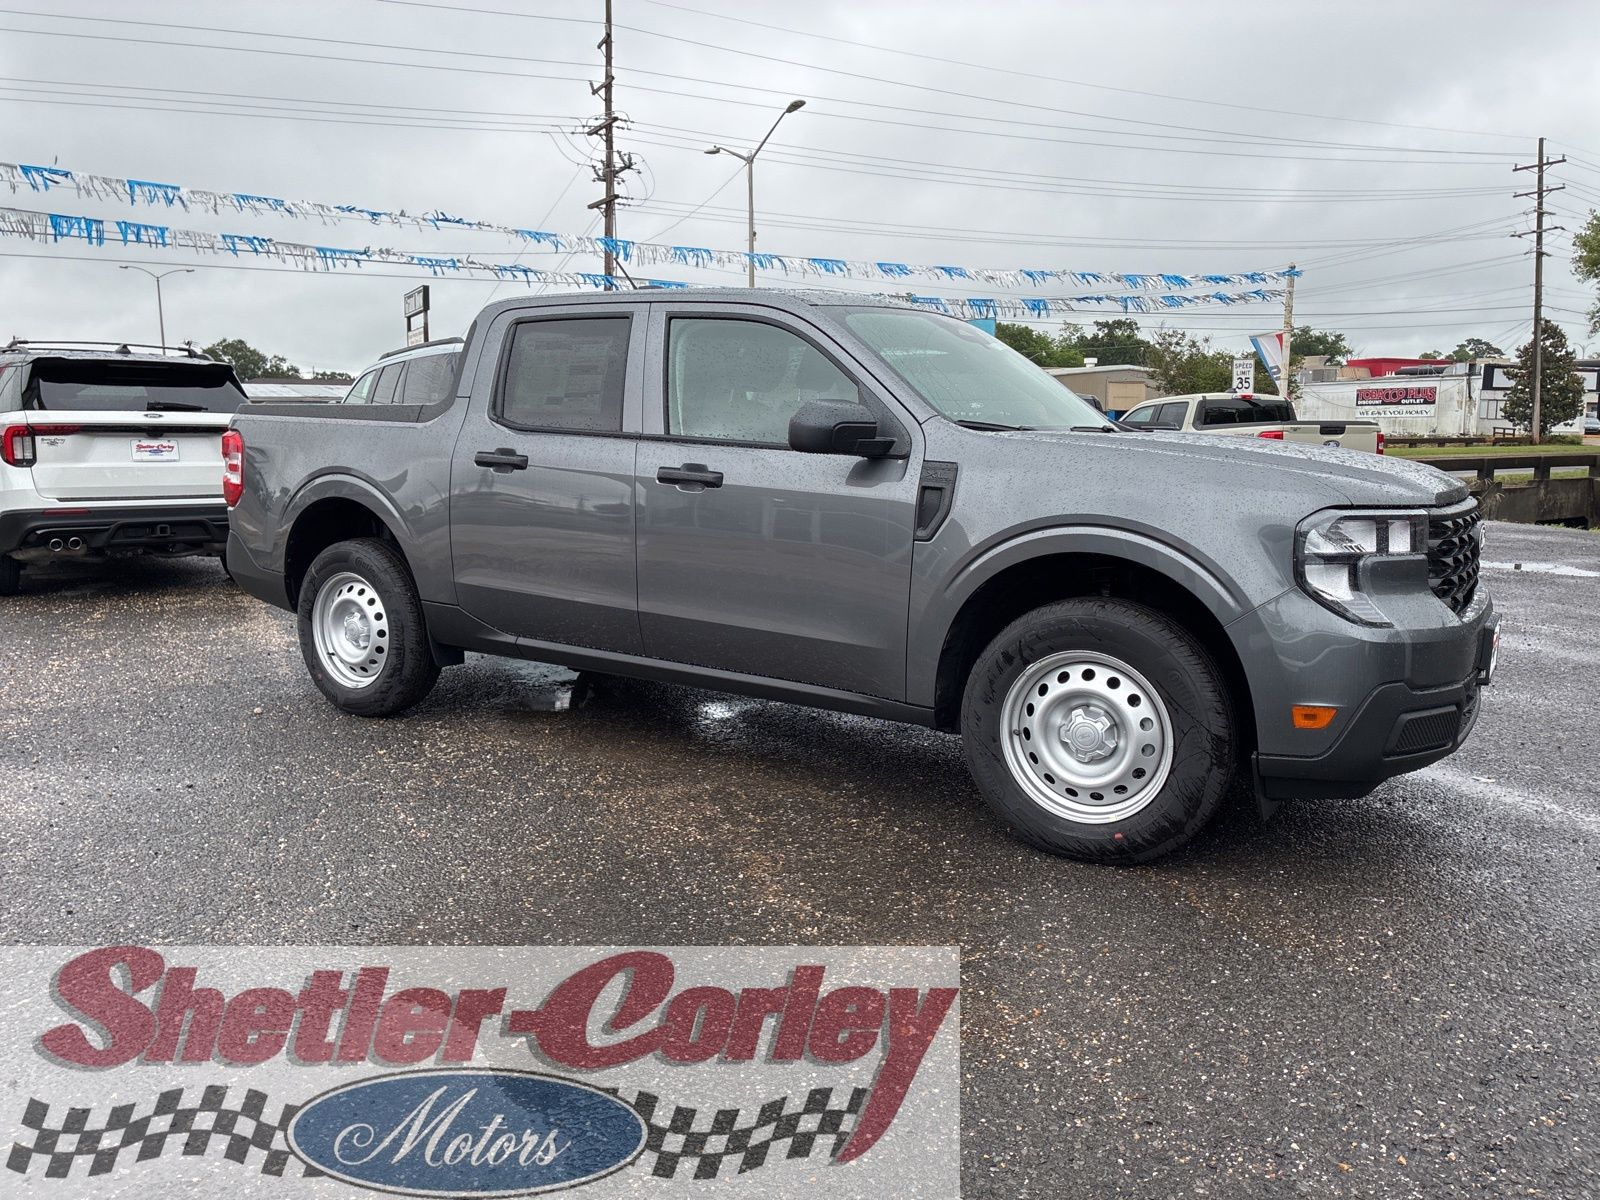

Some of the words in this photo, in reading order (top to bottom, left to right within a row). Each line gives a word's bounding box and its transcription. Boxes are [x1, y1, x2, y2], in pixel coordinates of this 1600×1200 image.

[1236, 377, 1250, 389] 35
[1358, 389, 1405, 402] TOBACCO
[1408, 387, 1435, 401] PLUS
